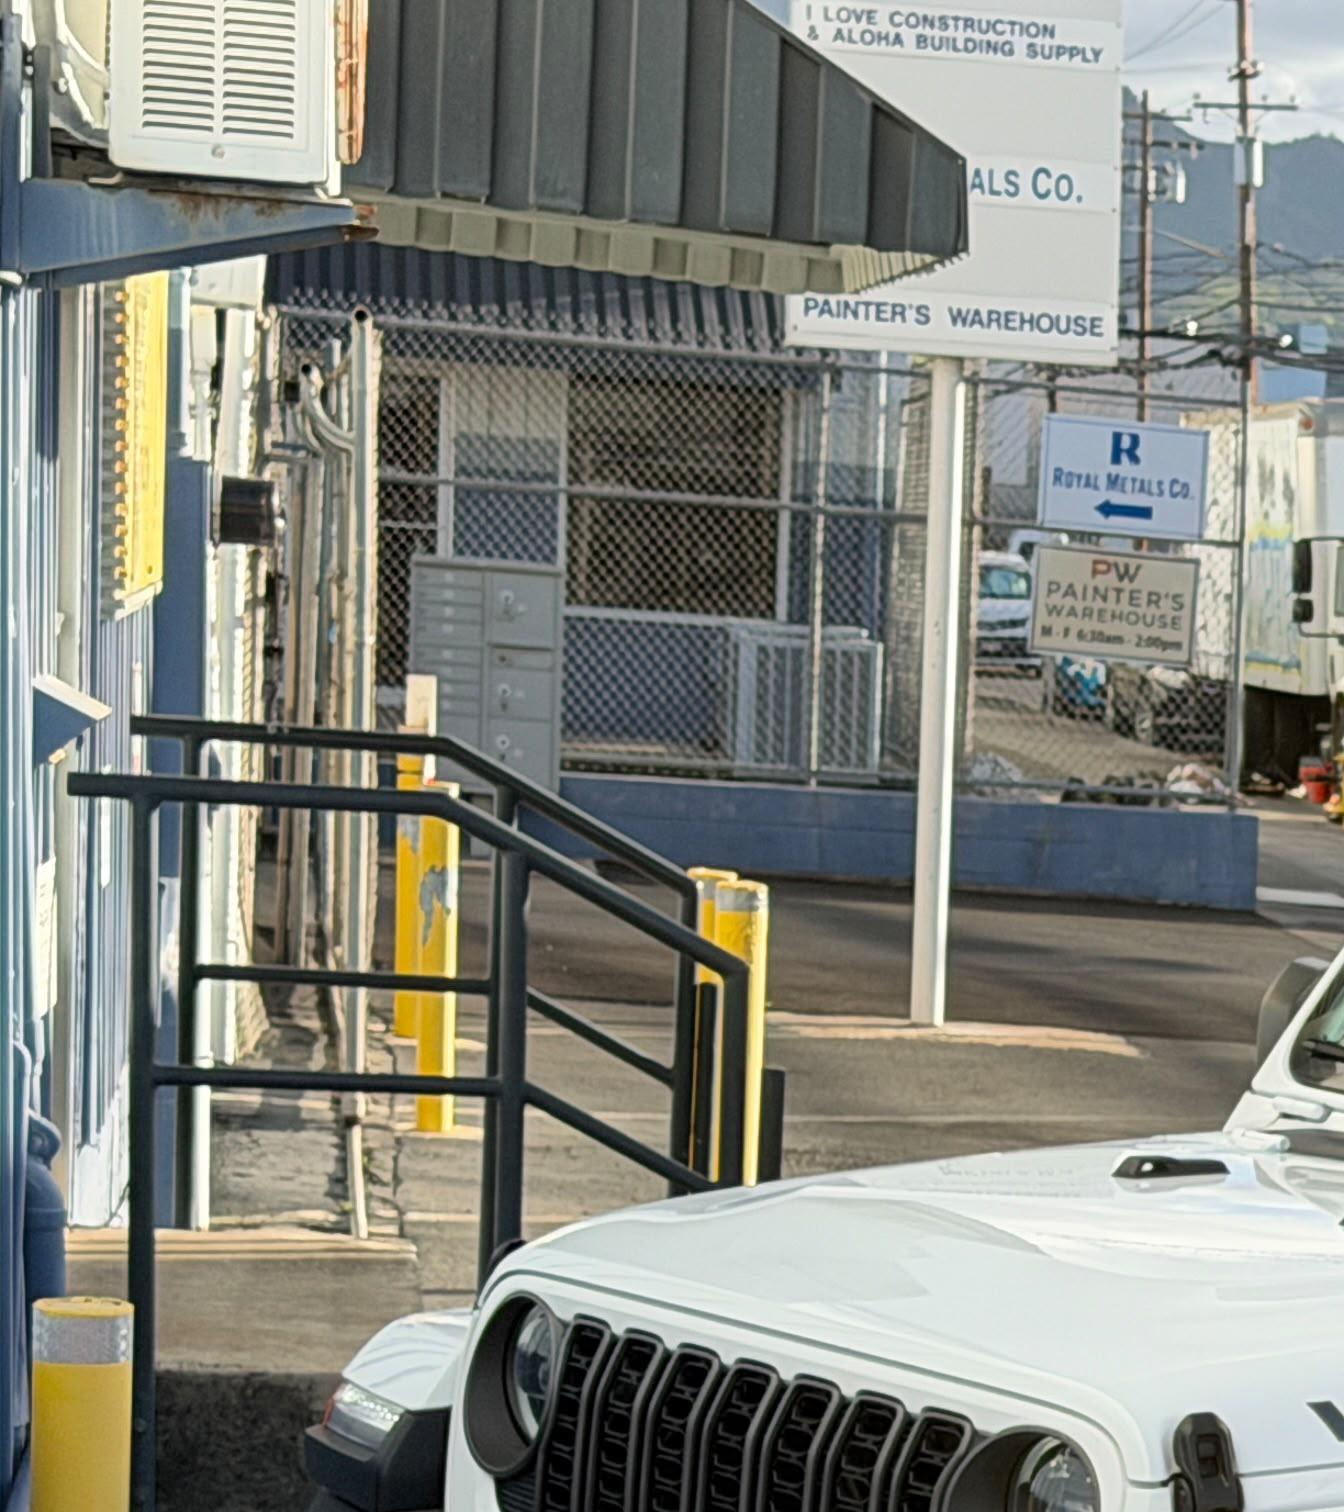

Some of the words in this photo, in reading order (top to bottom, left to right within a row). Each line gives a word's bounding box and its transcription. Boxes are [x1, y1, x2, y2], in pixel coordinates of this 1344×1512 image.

[823, 6, 879, 26] LOVE
[888, 10, 1057, 39] CONSTRUCTION
[806, 24, 820, 41] &
[832, 26, 905, 49] ALOHA
[915, 34, 1015, 58] BUILDING
[1025, 42, 1104, 64] SUPPLY
[803, 297, 931, 326] PAINTER'S
[947, 306, 1105, 338] WAREHOUSE
[1110, 430, 1142, 466] R
[1052, 467, 1100, 492] ROYAL
[1105, 472, 1164, 498] METALS
[1091, 559, 1143, 584] PW
[1046, 581, 1185, 612] PAINTER'S
[1041, 624, 1053, 638] M
[1044, 603, 1183, 631] WAREHOUSE
